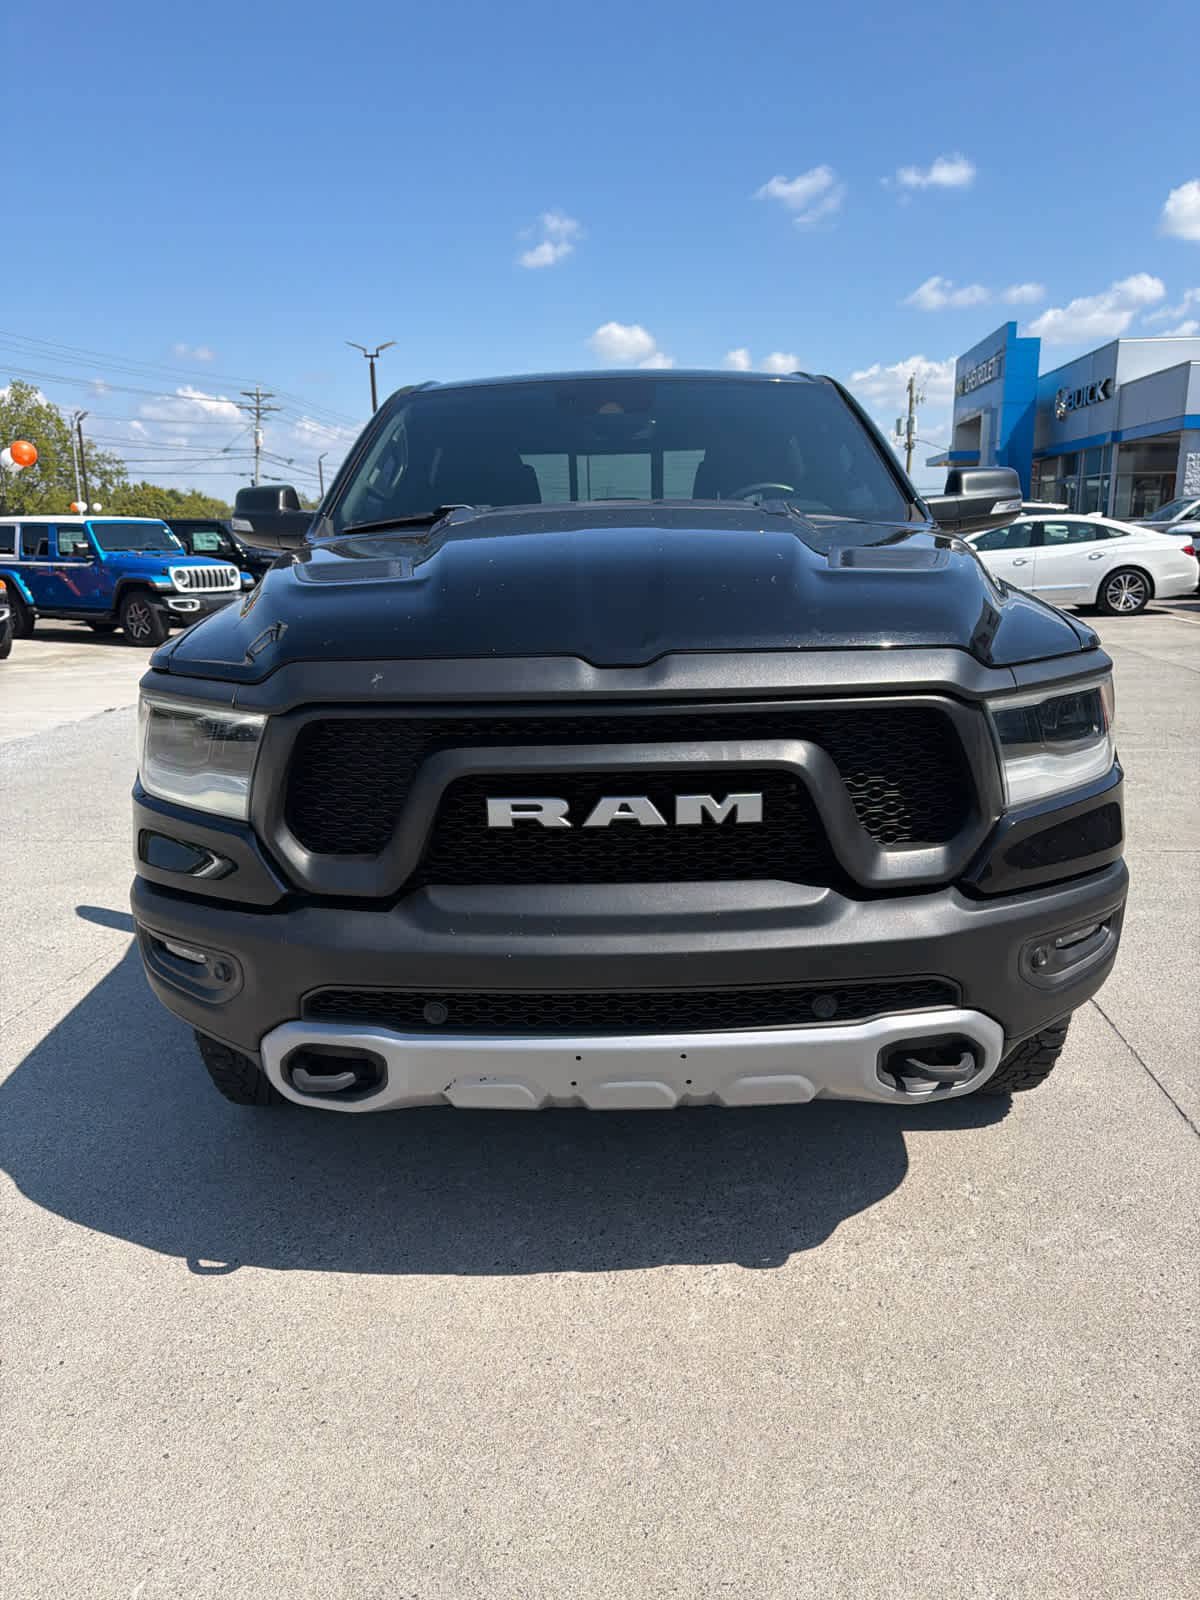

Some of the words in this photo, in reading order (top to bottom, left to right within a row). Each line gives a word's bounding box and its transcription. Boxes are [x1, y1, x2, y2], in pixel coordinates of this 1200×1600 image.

[964, 355, 1000, 392] CHEVROLET
[1065, 378, 1112, 410] BUICK
[487, 792, 763, 828] RAM
